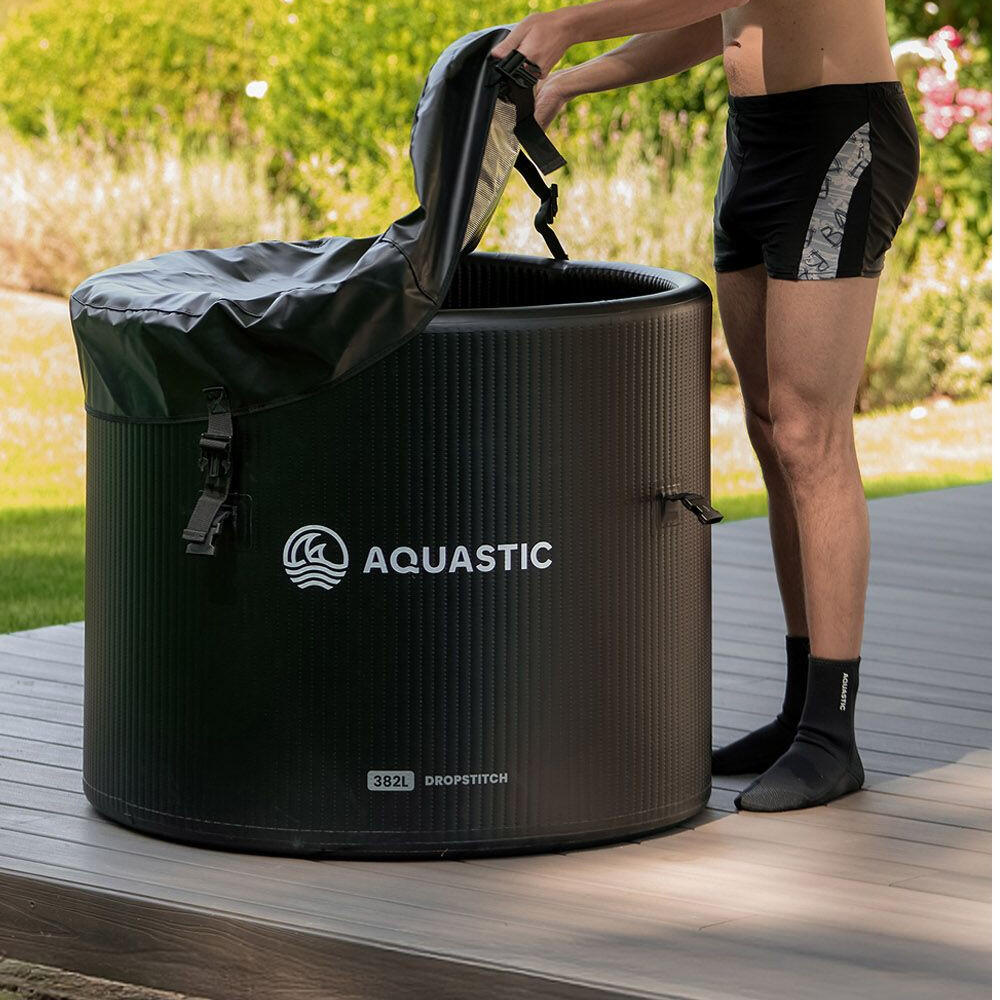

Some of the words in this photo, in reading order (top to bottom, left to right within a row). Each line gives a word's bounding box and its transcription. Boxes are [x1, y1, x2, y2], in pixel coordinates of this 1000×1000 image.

[362, 541, 554, 575] AQUASTIC
[839, 672, 849, 711] AQUASTIC
[372, 774, 409, 789] 382L
[424, 772, 509, 786] DROPSTITCH
